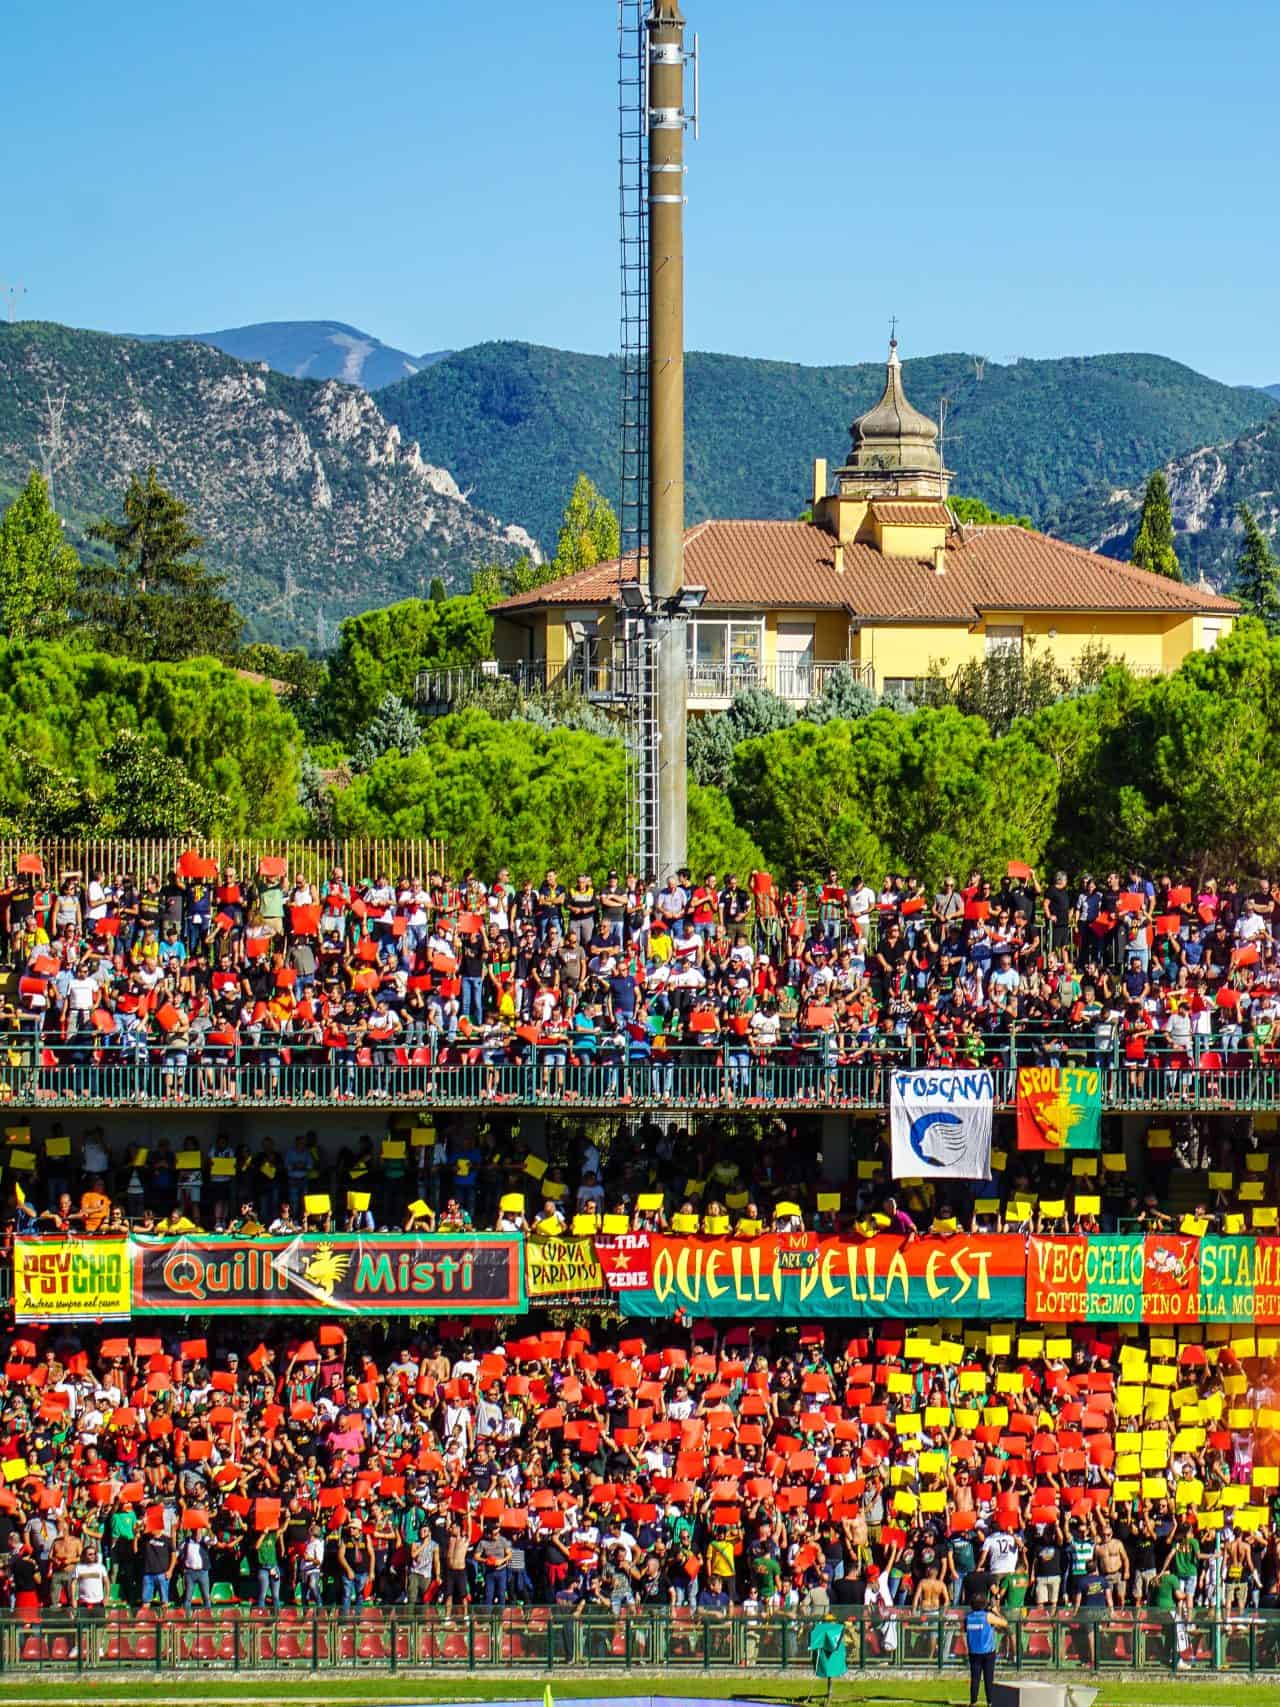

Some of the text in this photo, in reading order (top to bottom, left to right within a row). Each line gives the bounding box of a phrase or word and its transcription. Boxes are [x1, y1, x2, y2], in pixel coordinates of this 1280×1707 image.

[896, 1073, 993, 1101] TOSCANA
[1020, 1068, 1099, 1097] SPOLETO
[541, 1242, 585, 1262] CURVA
[789, 1232, 808, 1249] NO
[23, 1252, 121, 1295] PSYCHO
[354, 1250, 474, 1295] Misti
[530, 1263, 597, 1285] PARADISO
[653, 1246, 783, 1303] QUELLI
[925, 1247, 992, 1303] EST
[1035, 1242, 1145, 1286] VECCHIO
[606, 1271, 649, 1288] ZENE
[1035, 1291, 1136, 1316] LOTTEREMO
[1140, 1291, 1182, 1315] FINO
[1185, 1294, 1228, 1316] ALLA
[996, 1539, 1008, 1553] 12
